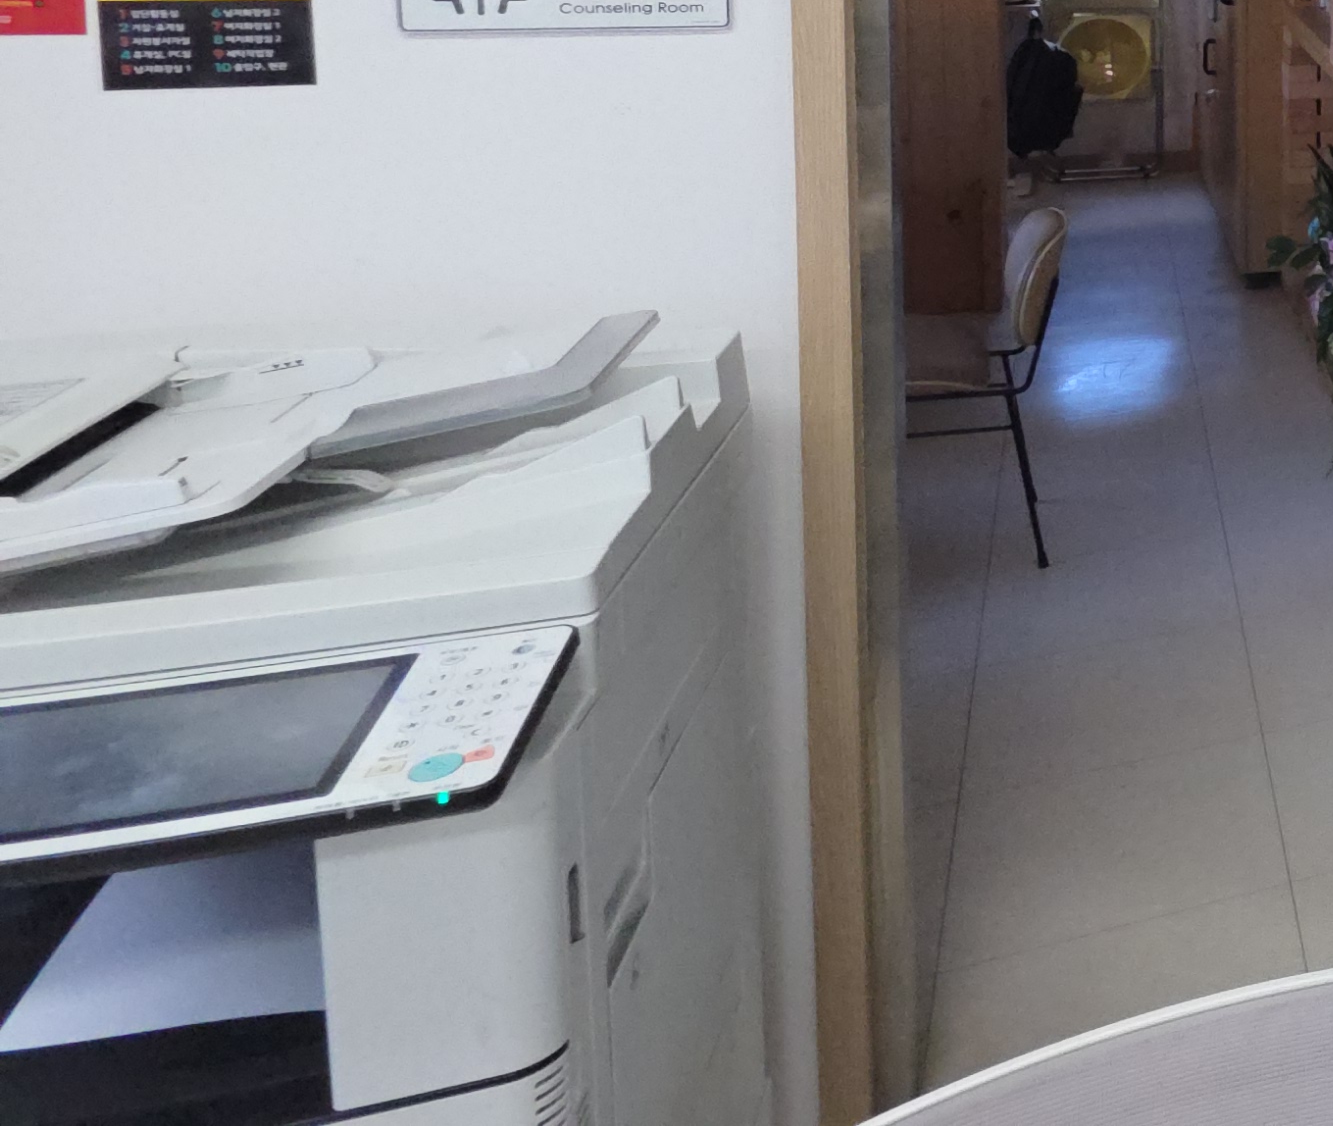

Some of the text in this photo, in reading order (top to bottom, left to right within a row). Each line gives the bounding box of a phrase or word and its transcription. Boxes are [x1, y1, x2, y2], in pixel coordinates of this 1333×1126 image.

[559, 1, 704, 15] Counseling Room
[214, 63, 232, 73] 10
